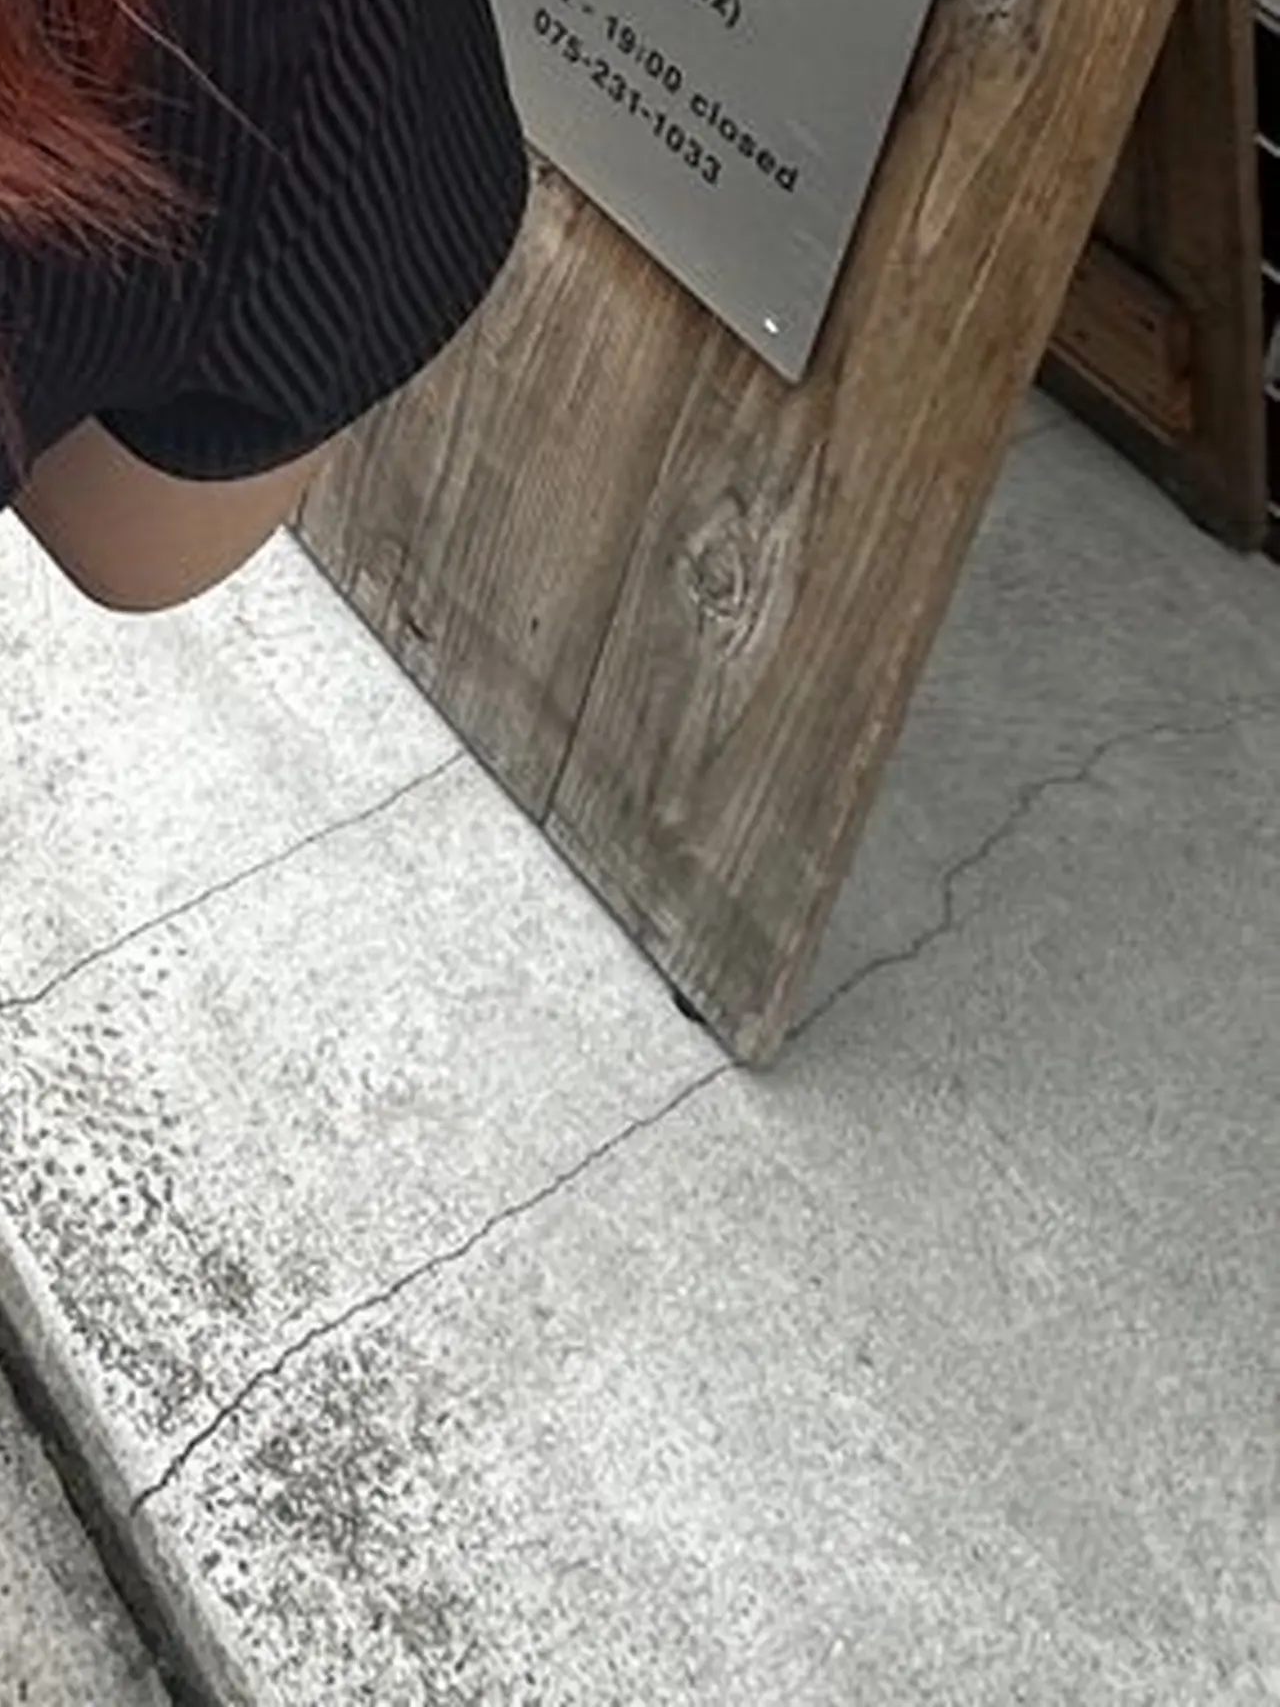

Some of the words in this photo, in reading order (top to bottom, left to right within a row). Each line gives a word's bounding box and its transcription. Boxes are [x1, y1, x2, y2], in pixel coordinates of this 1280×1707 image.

[534, 7, 722, 186] 075-231-1033
[605, 15, 683, 94] 19:00
[690, 93, 799, 193] closed
